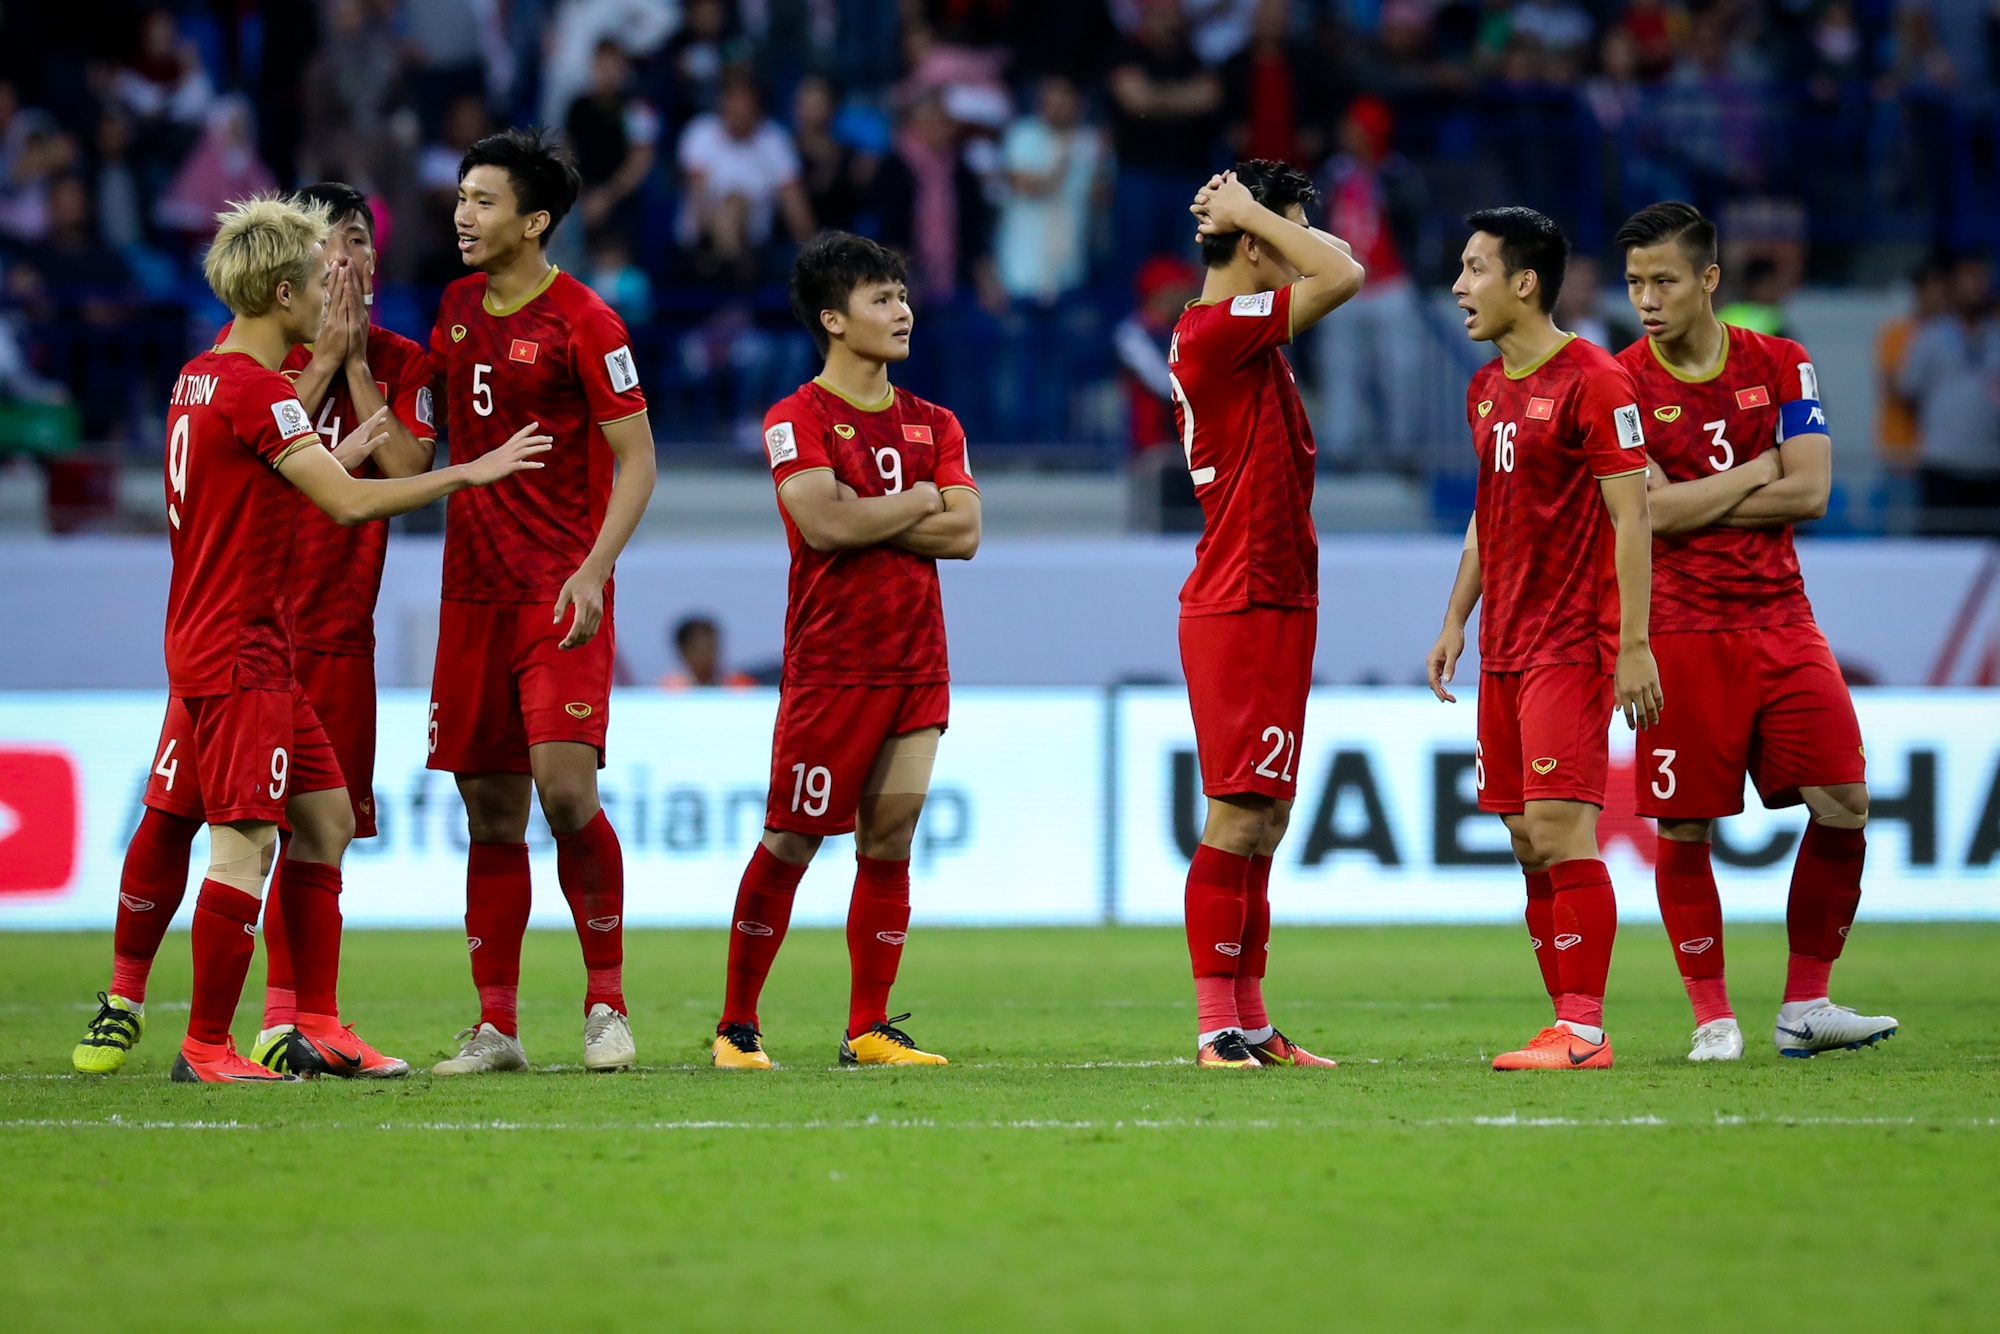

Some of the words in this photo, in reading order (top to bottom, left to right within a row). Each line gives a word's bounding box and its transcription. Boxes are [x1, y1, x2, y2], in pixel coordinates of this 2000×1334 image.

[472, 364, 494, 417] 5
[284, 428, 300, 436] ASIAN
[315, 397, 341, 449] 4
[1493, 421, 1518, 473] 16
[1703, 419, 1735, 472] 3
[169, 414, 190, 530] 9
[871, 446, 903, 496] 9
[428, 702, 440, 754] 5
[1255, 725, 1295, 783] 22
[155, 738, 178, 792] 4
[269, 747, 289, 800] 9
[791, 762, 832, 817] 19
[1651, 748, 1677, 800] 3
